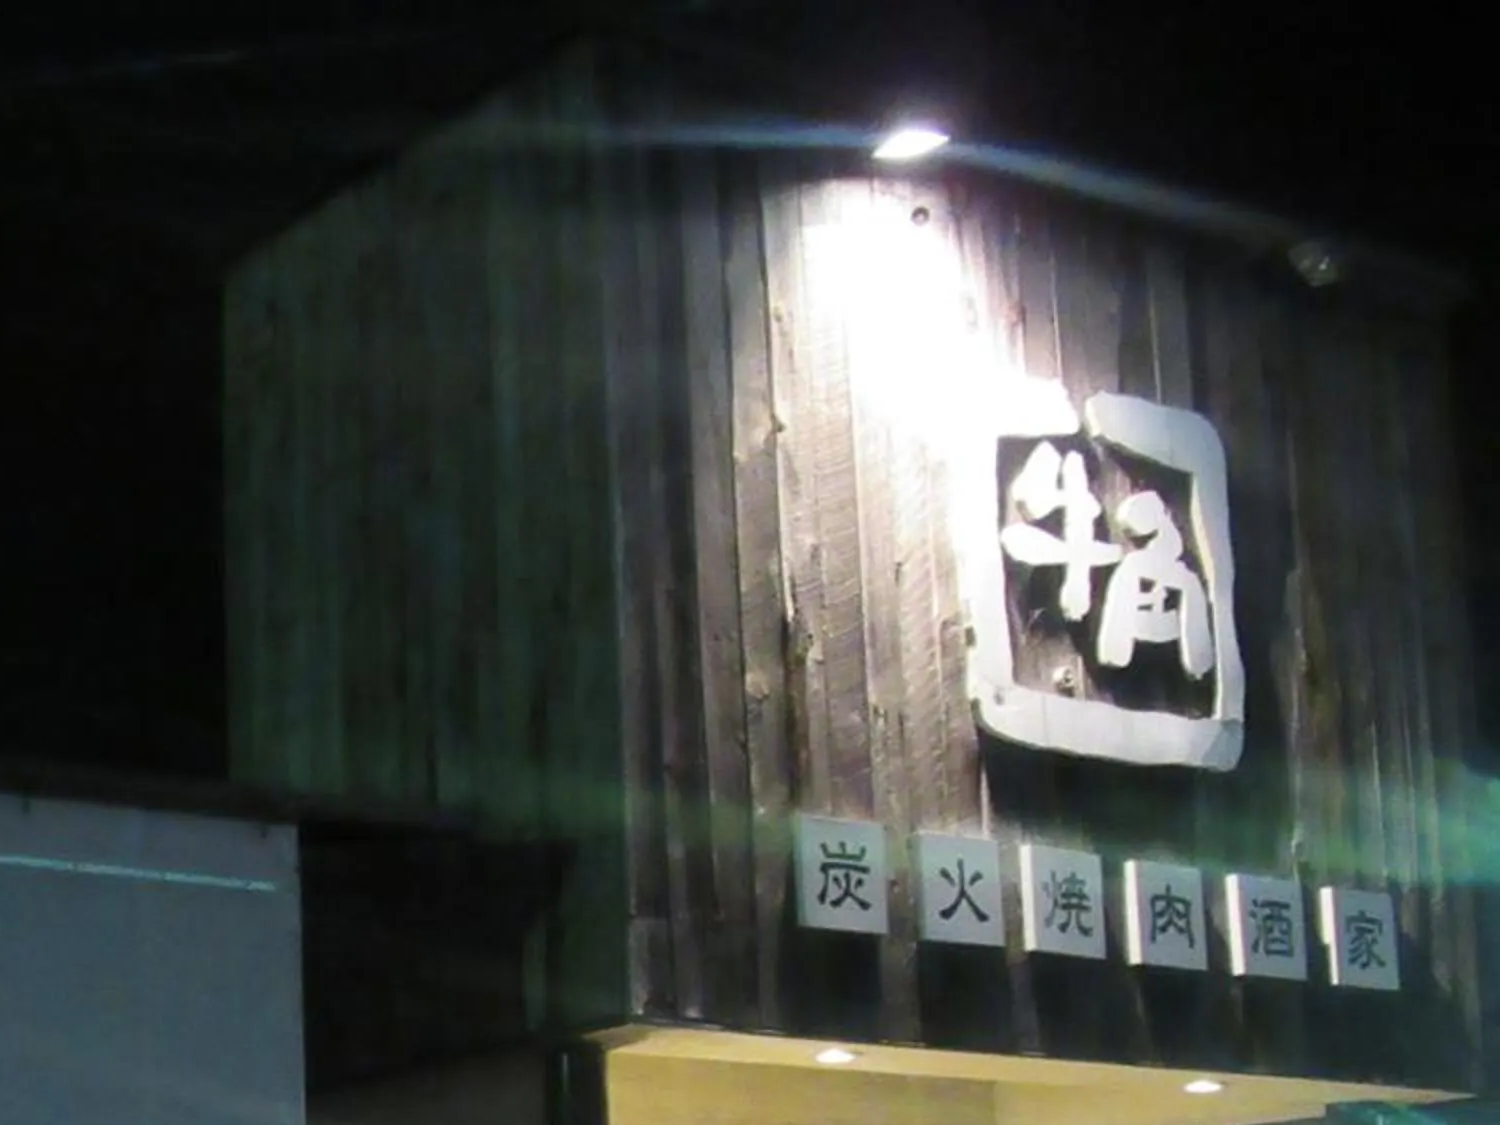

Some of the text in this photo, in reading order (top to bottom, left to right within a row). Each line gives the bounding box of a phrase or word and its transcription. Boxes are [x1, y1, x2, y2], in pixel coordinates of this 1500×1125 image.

[1000, 440, 1216, 681] 牛角
[816, 840, 1387, 971] 炭火焼肉酒家
